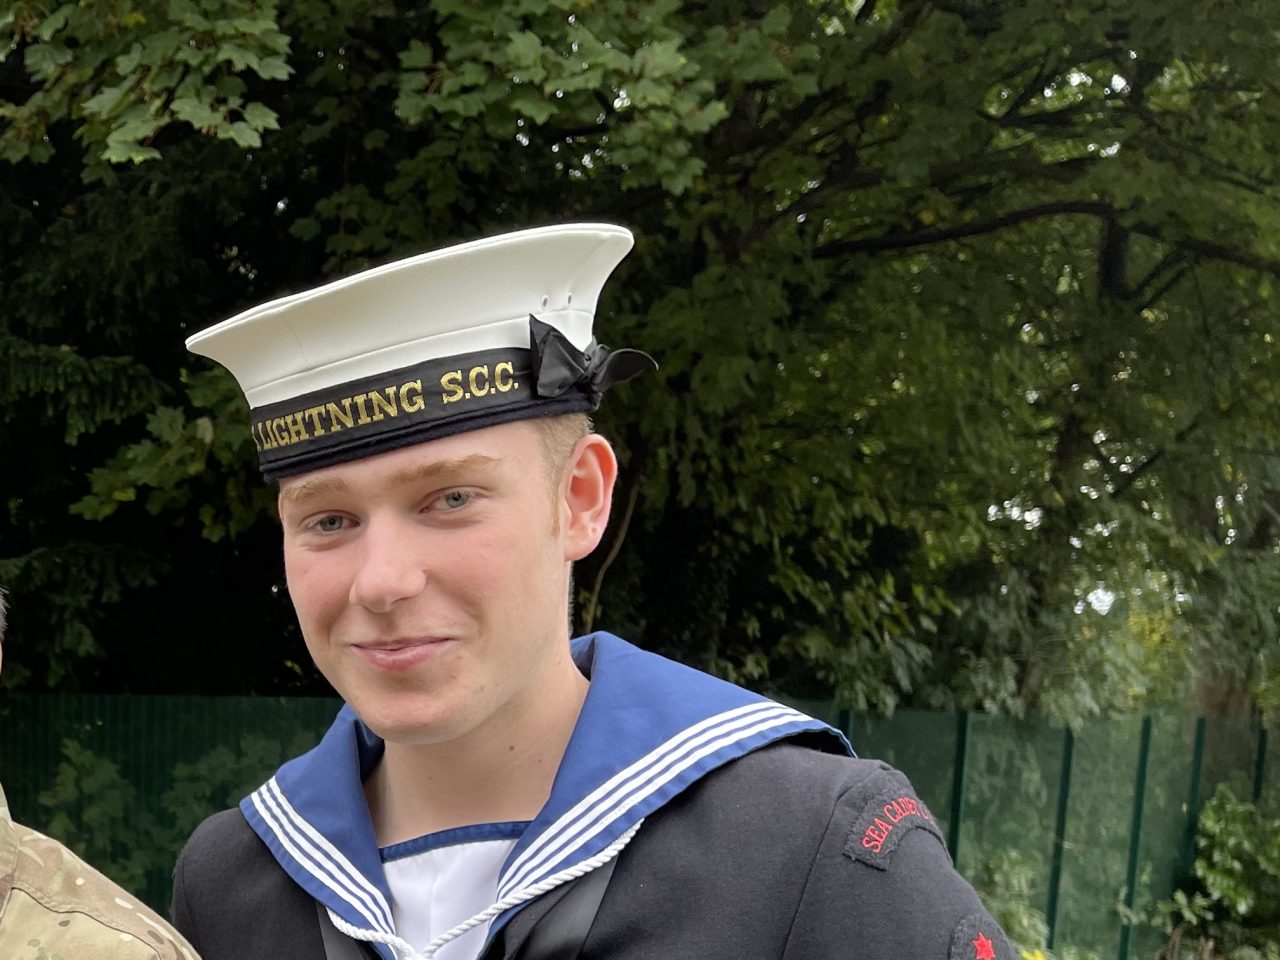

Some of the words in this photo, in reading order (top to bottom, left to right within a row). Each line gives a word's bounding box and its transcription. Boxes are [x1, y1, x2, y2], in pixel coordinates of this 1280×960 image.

[257, 379, 425, 451] LIGHTNING
[440, 361, 519, 404] S.C.C.
[862, 817, 893, 854] SEA
